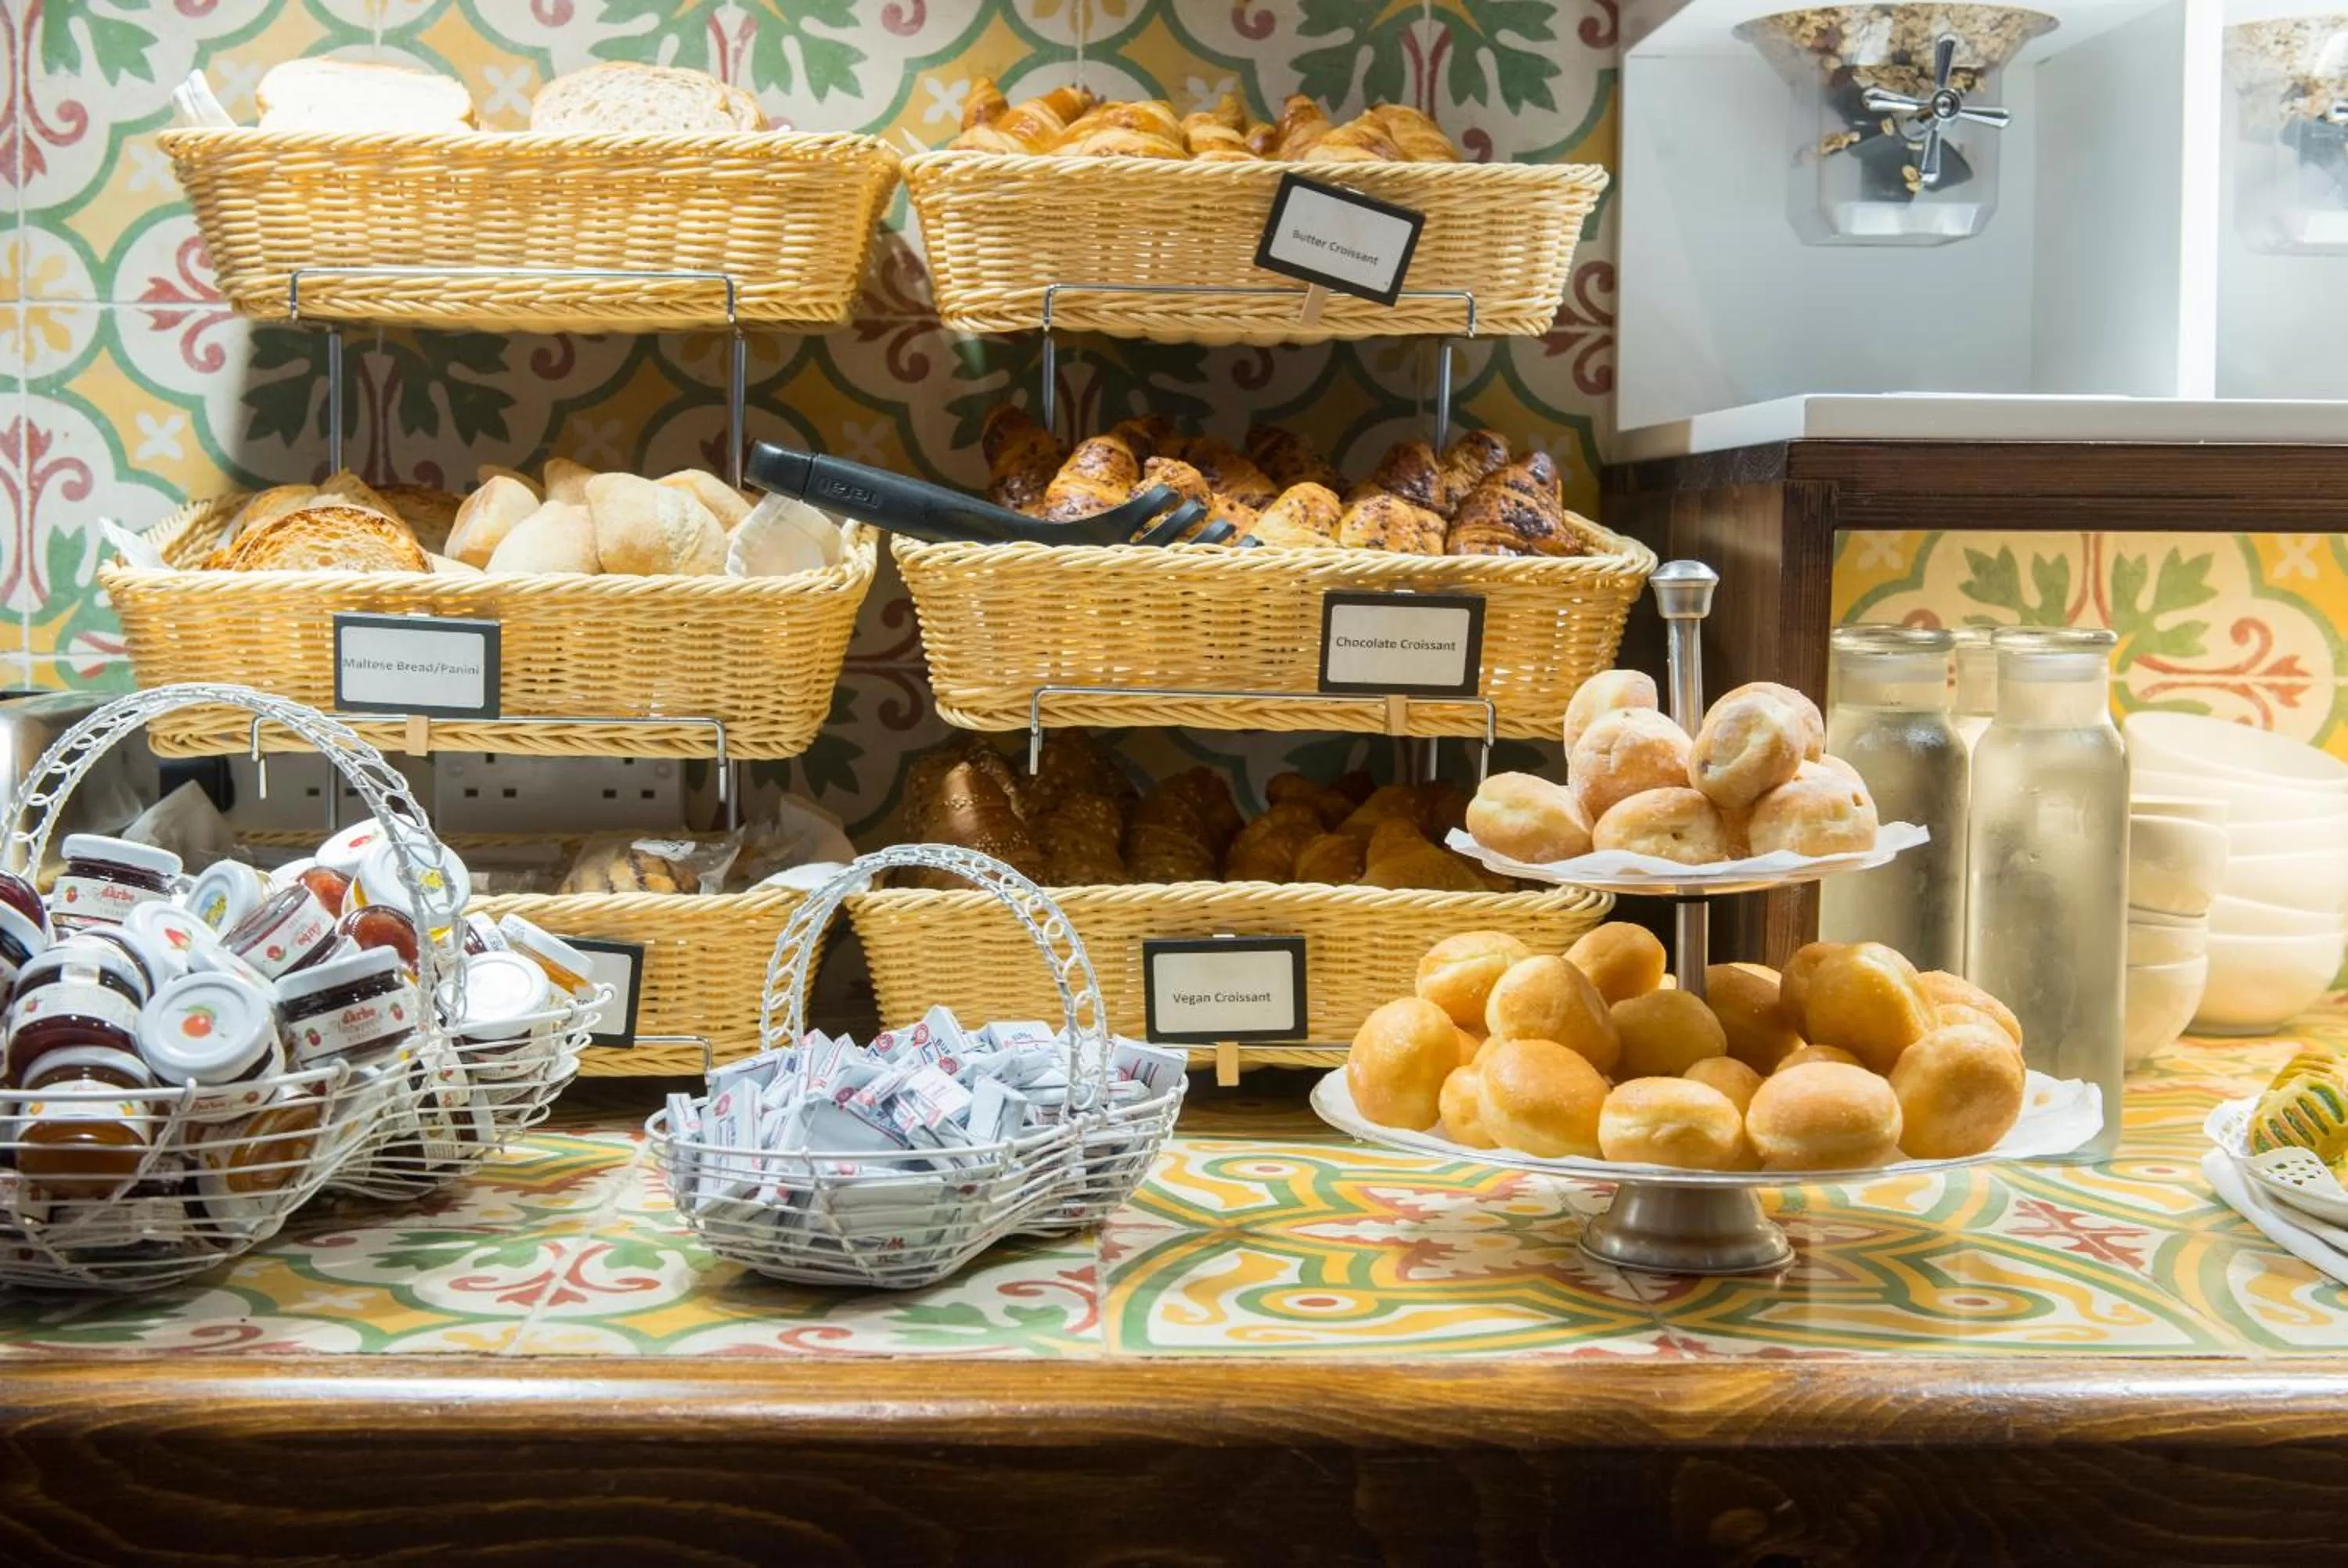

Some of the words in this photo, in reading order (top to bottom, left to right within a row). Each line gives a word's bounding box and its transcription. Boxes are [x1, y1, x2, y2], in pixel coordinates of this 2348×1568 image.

[1292, 229, 1328, 248] Butter
[1329, 241, 1378, 266] Croissant
[1336, 636, 1397, 649] Chocolate
[1400, 638, 1456, 652] Croissant
[343, 657, 394, 671] Maltese
[397, 661, 480, 675] Bread/Panini
[1172, 992, 1211, 1005] Vegan
[1214, 991, 1271, 1002] Croissant
